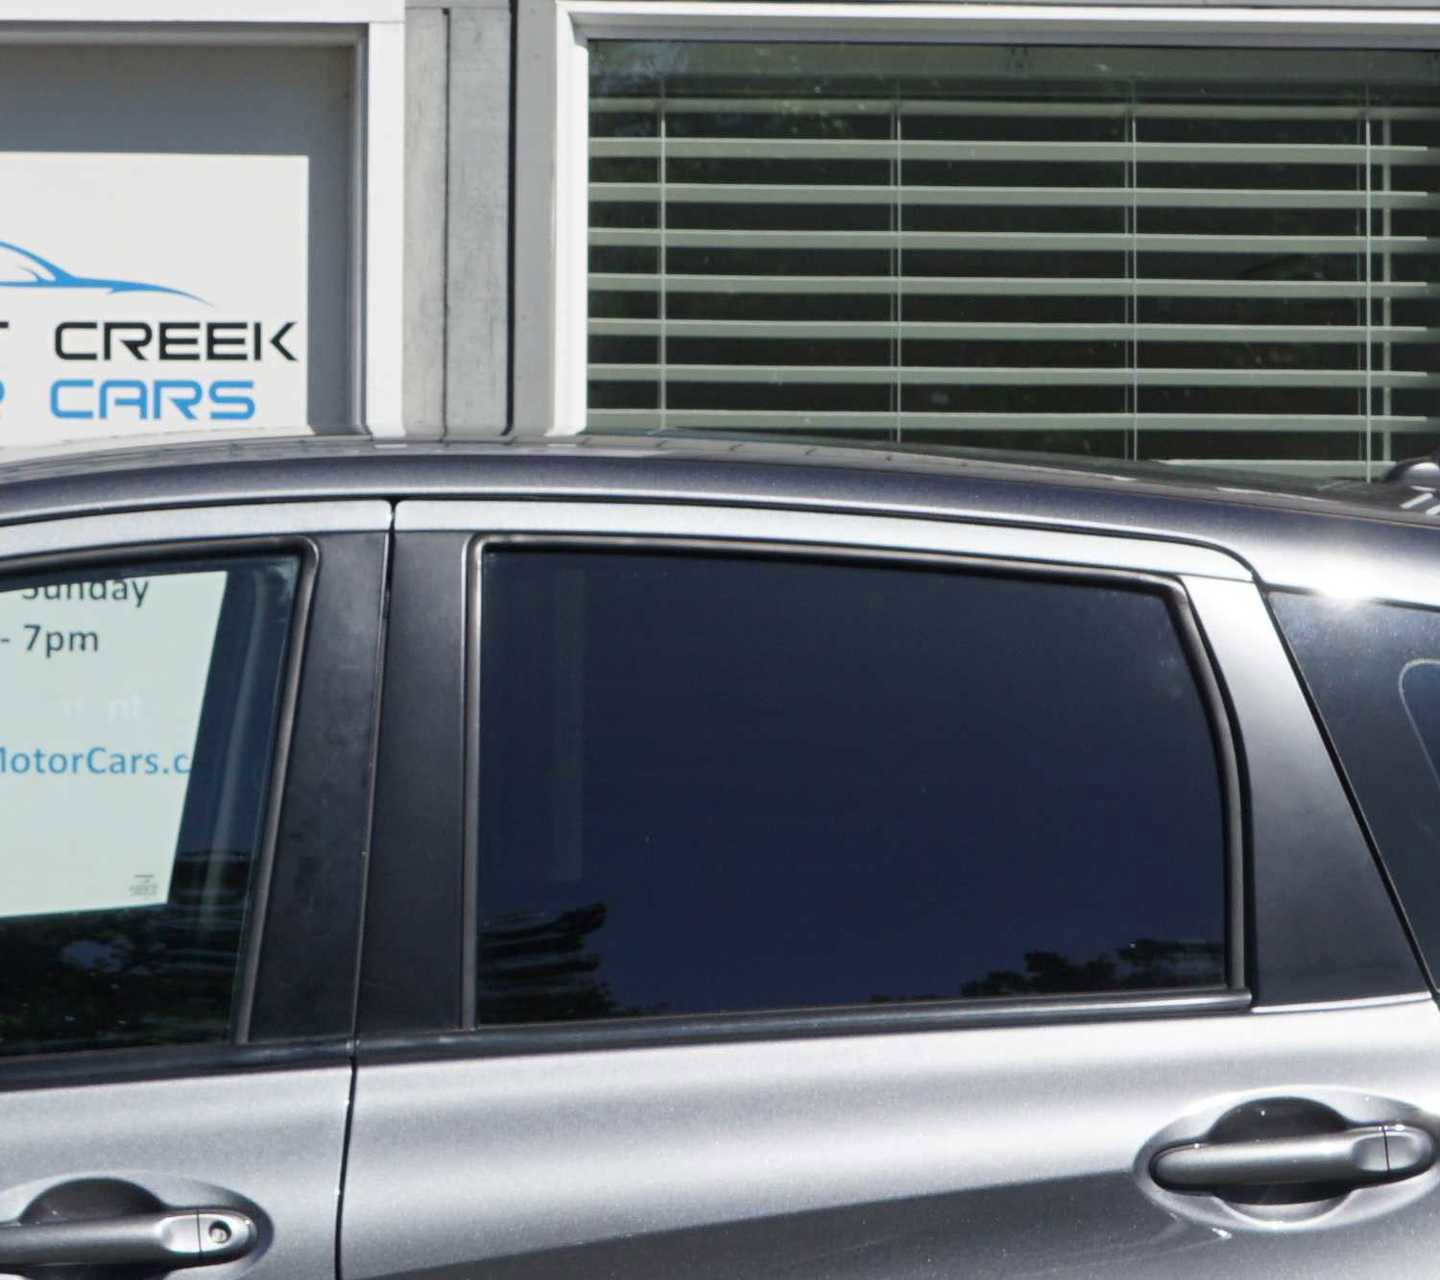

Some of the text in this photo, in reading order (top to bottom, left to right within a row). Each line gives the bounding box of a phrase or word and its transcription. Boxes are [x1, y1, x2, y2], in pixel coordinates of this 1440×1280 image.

[54, 321, 298, 362] CREEK
[49, 379, 257, 421] CARS
[24, 623, 100, 659] 7pm
